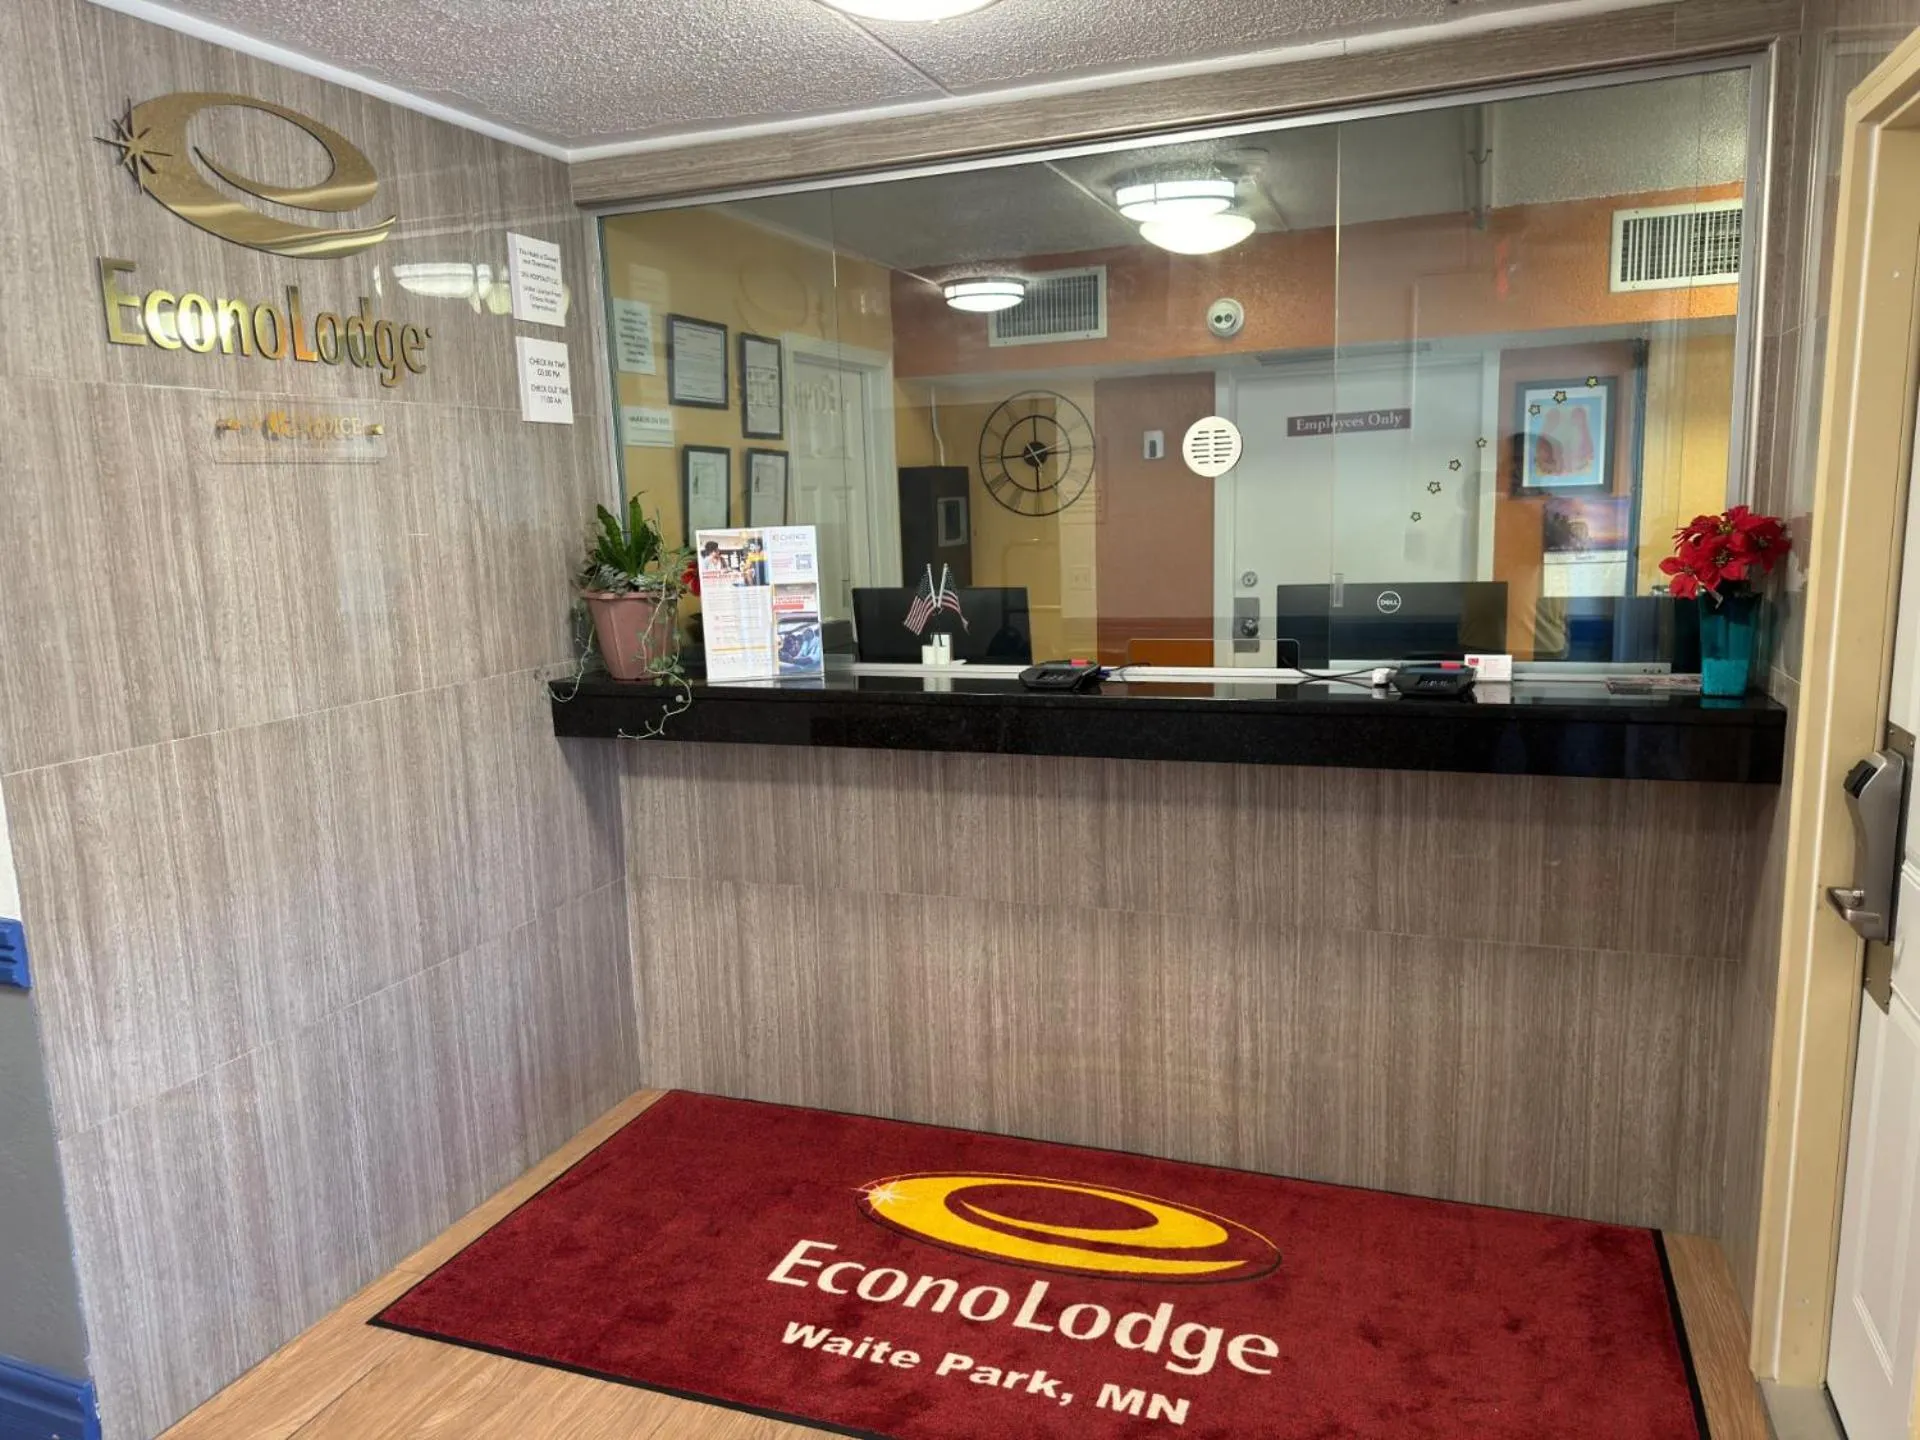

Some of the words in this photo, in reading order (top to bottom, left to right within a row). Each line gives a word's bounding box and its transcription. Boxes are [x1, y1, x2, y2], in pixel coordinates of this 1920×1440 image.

[97, 256, 430, 388] EconoLodge
[1296, 416, 1365, 432] Employees
[1367, 411, 1403, 427] Only
[766, 1239, 1279, 1375] EconoLodge
[782, 1321, 921, 1369] Waite
[935, 1352, 1074, 1407] Park,
[1095, 1383, 1190, 1426] MN
